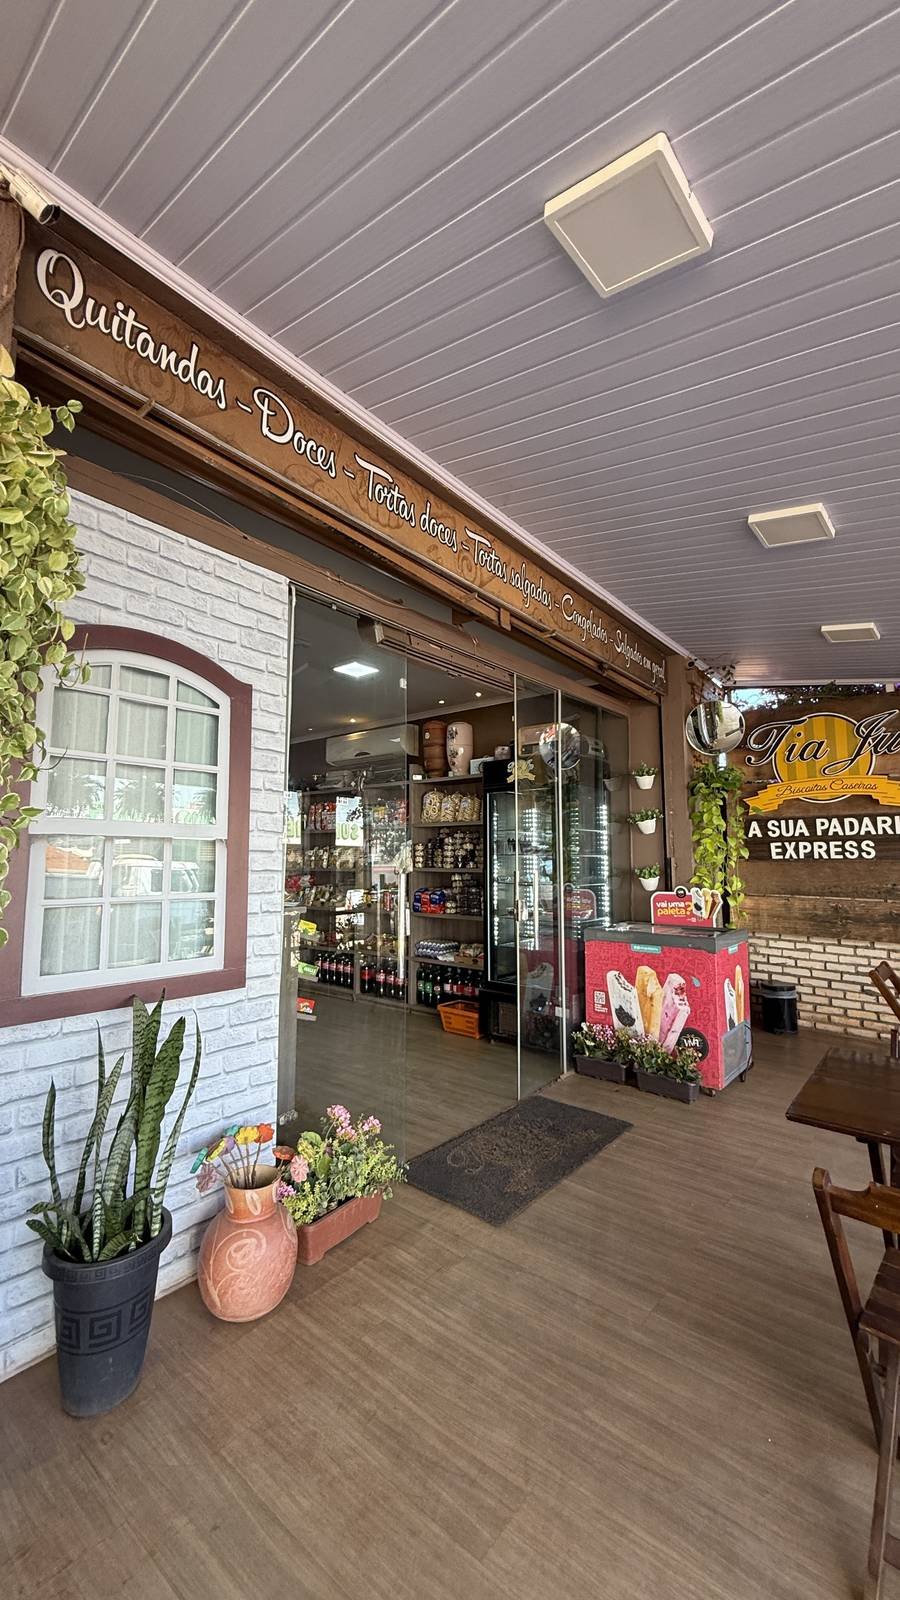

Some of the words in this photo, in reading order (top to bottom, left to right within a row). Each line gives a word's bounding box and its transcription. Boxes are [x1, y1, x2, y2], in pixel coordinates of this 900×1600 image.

[36, 248, 227, 411] Quitandas
[252, 387, 338, 479] Doces
[354, 452, 416, 528] Tortas
[420, 500, 458, 552] doces
[464, 526, 508, 584] Tortas
[509, 561, 552, 611] salgadas
[561, 593, 608, 643] Congelados
[613, 628, 643, 668] Salgados
[642, 656, 653, 671] em
[651, 659, 667, 684] geral
[746, 716, 829, 767] Tia
[775, 783, 828, 798] Biscoitos
[828, 778, 878, 792] Caseiros
[747, 820, 763, 838] A
[766, 818, 811, 838] SUA
[769, 839, 877, 860] EXPRESS
[655, 900, 668, 909] vai
[668, 901, 686, 909] uma
